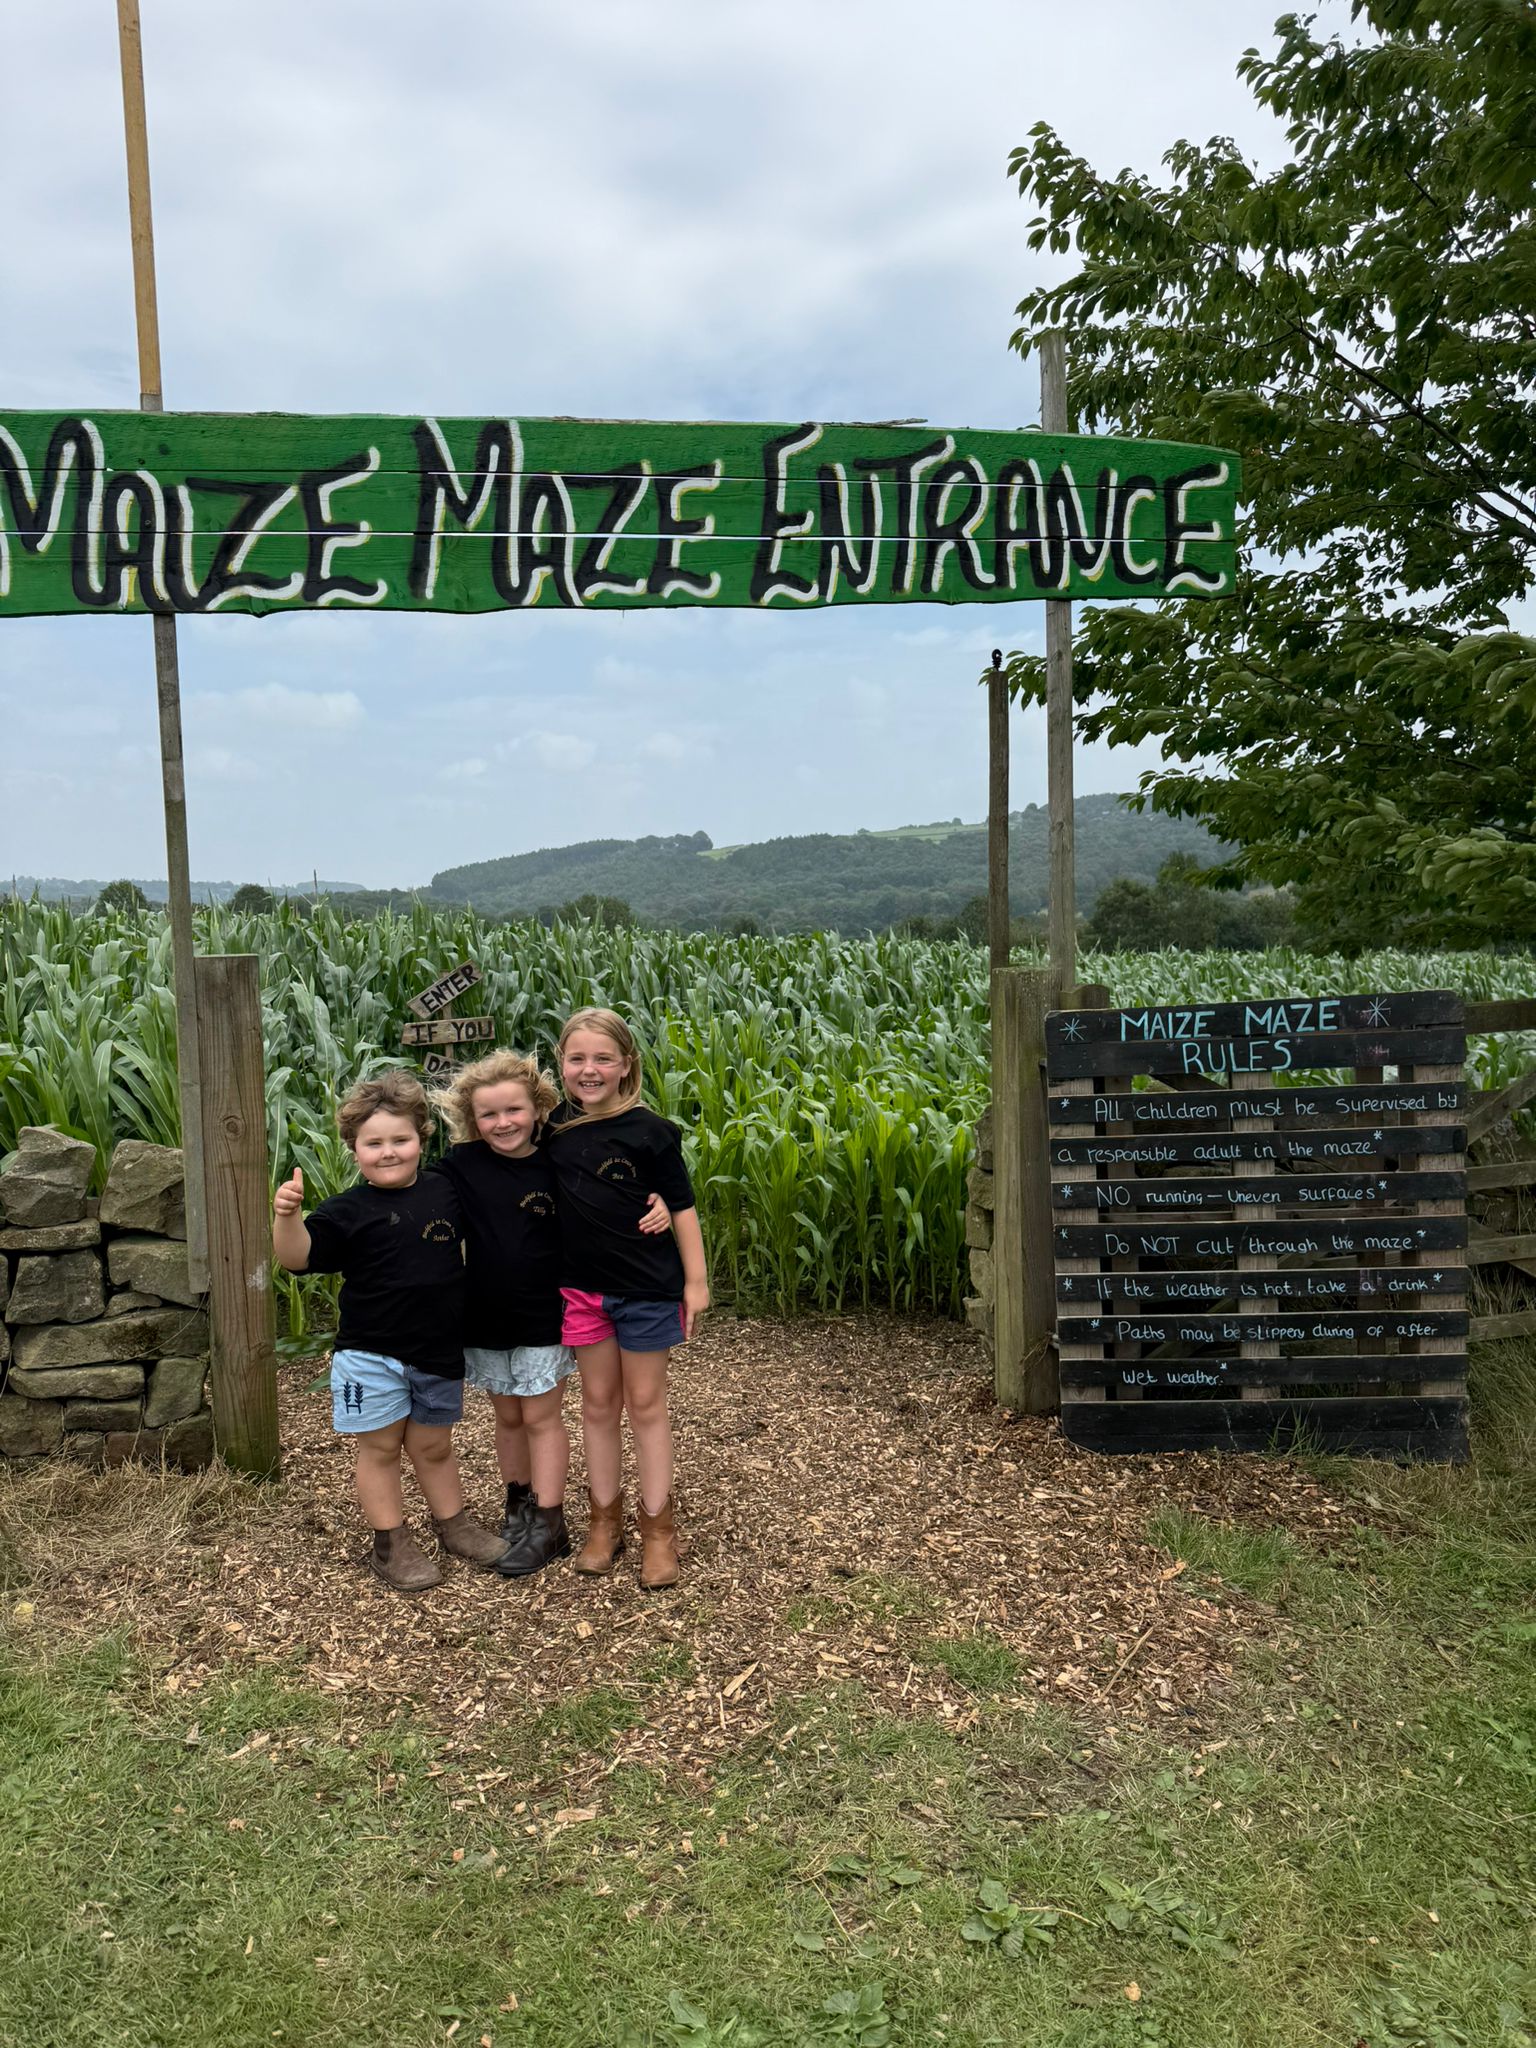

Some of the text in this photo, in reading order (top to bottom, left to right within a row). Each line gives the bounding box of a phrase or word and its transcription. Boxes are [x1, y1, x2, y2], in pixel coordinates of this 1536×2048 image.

[0, 418, 1228, 611] MAIZE MAZE ENTRANCE
[420, 964, 478, 1014] ENTER
[410, 1020, 493, 1044] IF YOU
[1120, 1000, 1341, 1042] MAIZE MAZE
[1182, 1038, 1292, 1074] RULES
[1136, 1101, 1218, 1120] children
[1295, 1097, 1319, 1116] be
[1438, 1092, 1457, 1109] by
[1057, 1148, 1076, 1163] a
[1087, 1146, 1178, 1164] responsible
[1193, 1144, 1242, 1160] adult
[1254, 1142, 1277, 1158] in
[1288, 1141, 1313, 1157] the
[1096, 1184, 1131, 1207] NO
[1298, 1187, 1376, 1201] surfaces
[1105, 1233, 1130, 1256] Do
[1140, 1235, 1180, 1255] NOT
[1196, 1237, 1234, 1255] cut
[1249, 1237, 1318, 1255] through
[1331, 1235, 1354, 1250] the
[1097, 1278, 1113, 1300] If
[1123, 1277, 1154, 1297] the
[1166, 1281, 1229, 1298] weather
[1240, 1282, 1257, 1296] is
[1307, 1277, 1347, 1294] take
[1361, 1281, 1376, 1293] a
[1117, 1321, 1166, 1341] Paths
[1180, 1327, 1214, 1343] may
[1223, 1323, 1241, 1339] be
[1312, 1323, 1354, 1340] during
[1396, 1323, 1439, 1337] after
